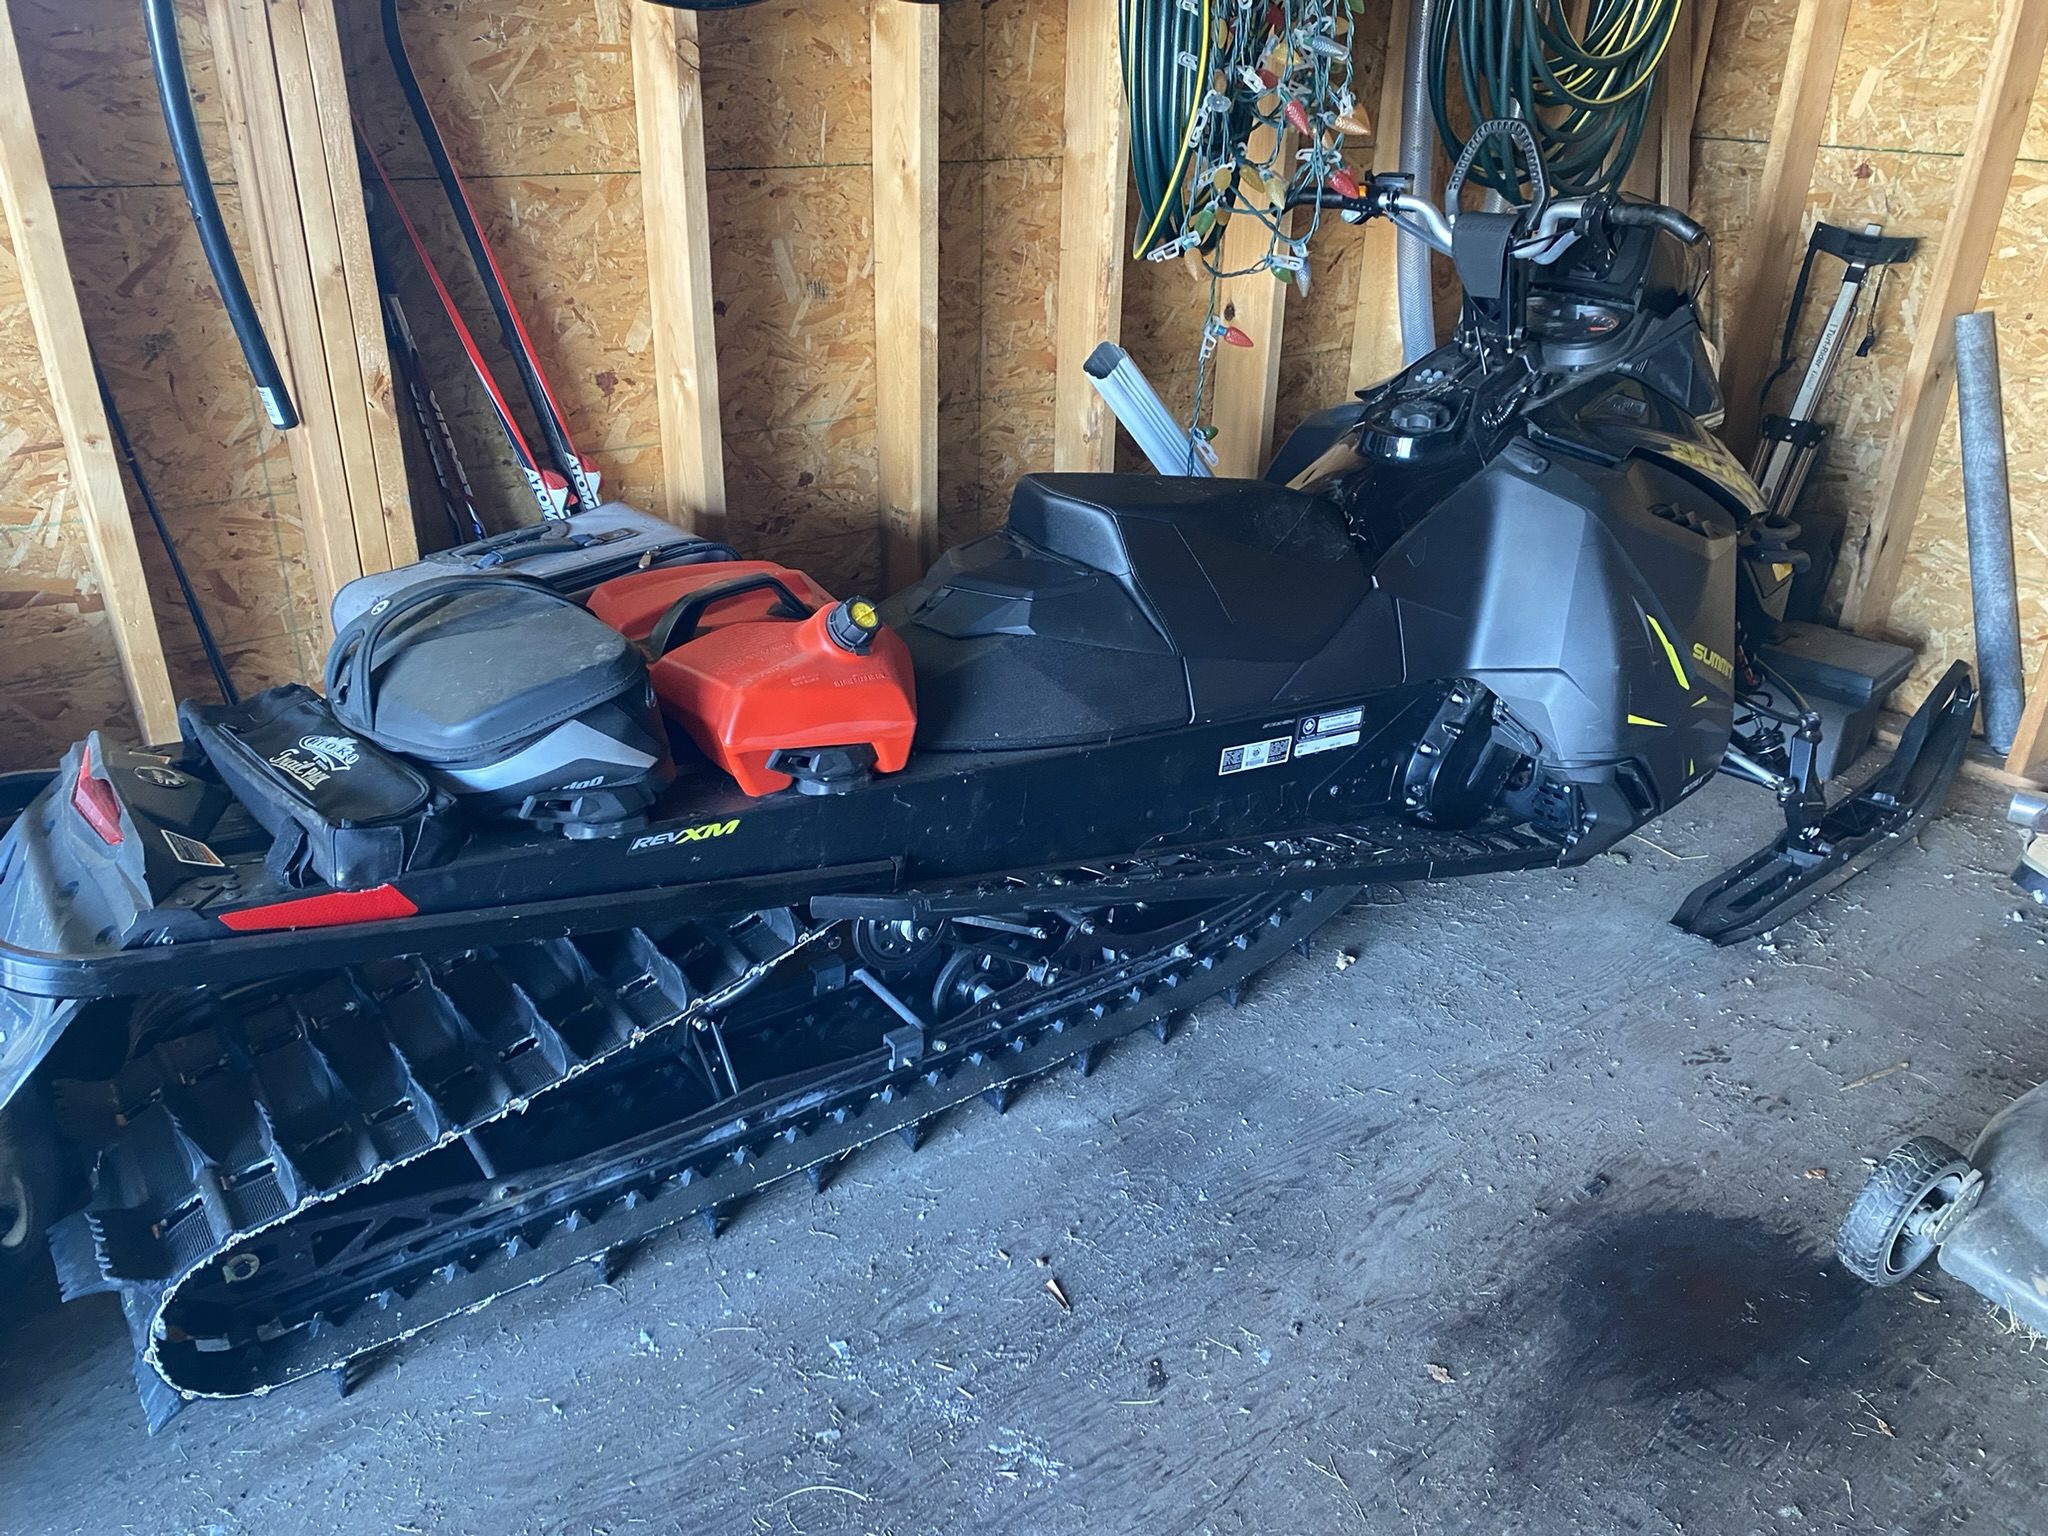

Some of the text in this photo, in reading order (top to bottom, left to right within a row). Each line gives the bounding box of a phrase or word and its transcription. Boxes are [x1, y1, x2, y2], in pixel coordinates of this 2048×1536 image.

[1815, 329, 1837, 368] Turf-Rider
[1692, 642, 1734, 680] SUMMIT
[269, 748, 316, 775] Trail
